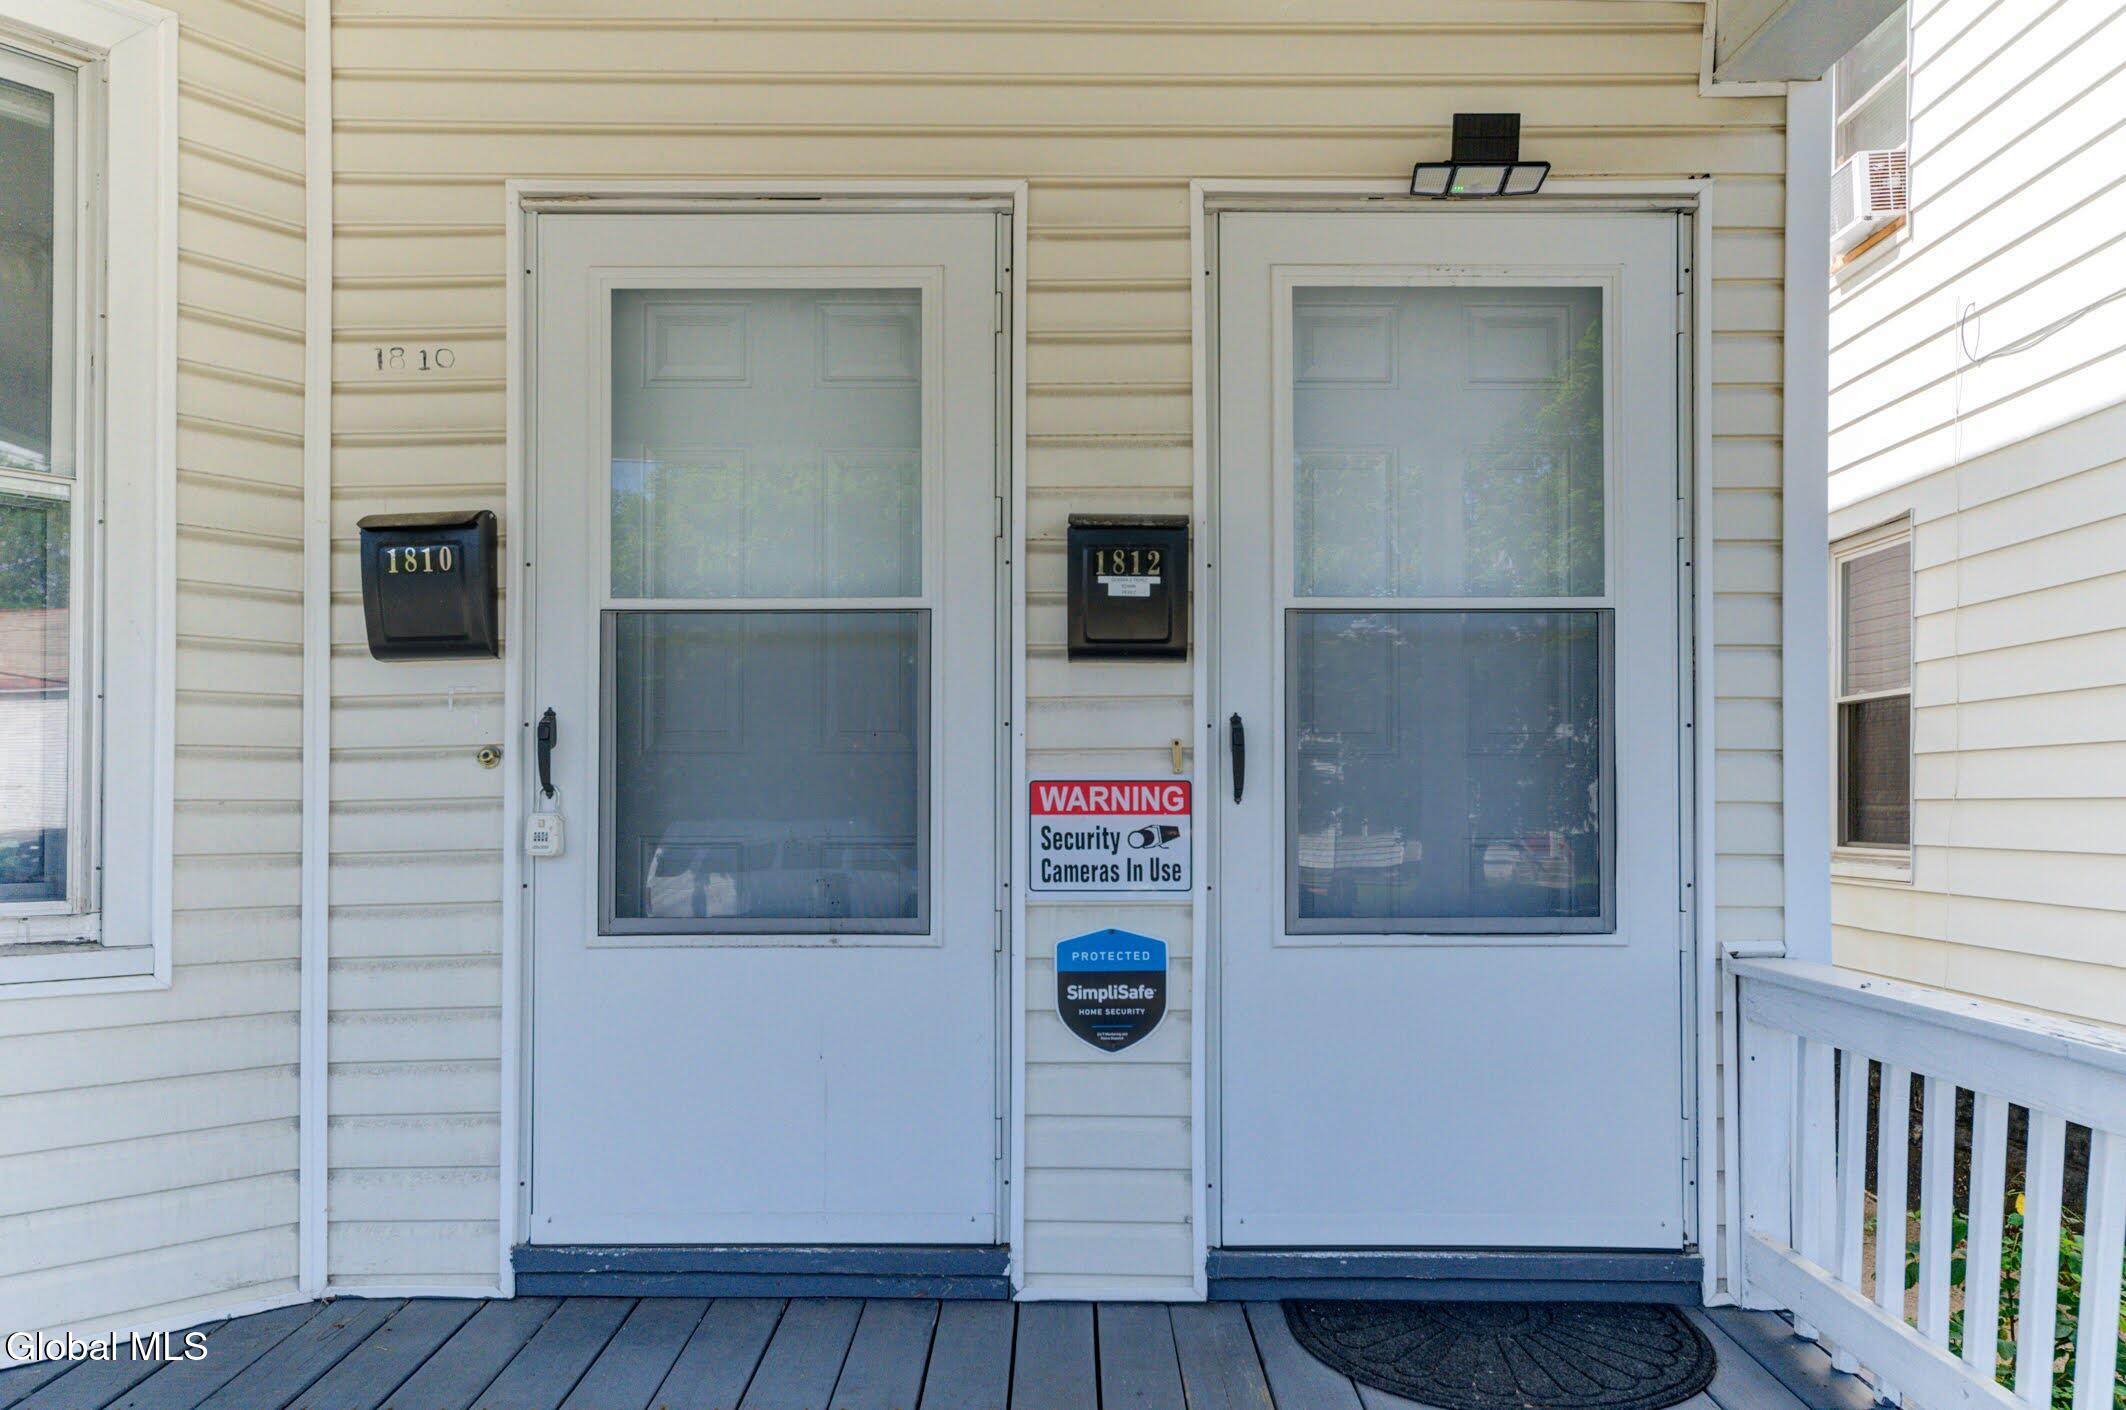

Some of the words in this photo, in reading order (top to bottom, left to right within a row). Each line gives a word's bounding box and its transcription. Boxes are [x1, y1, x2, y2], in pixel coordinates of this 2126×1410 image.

[386, 545, 453, 574] 1810
[1095, 549, 1161, 576] 1812
[1039, 785, 1185, 812] WARNING
[1041, 825, 1121, 855] Security
[1041, 857, 1120, 883] Cameras
[1127, 857, 1143, 882] In
[1150, 857, 1182, 882] Use
[1071, 951, 1151, 961] PROTECTED
[1066, 984, 1156, 1003] SimpliSafe
[1078, 1008, 1103, 1016] HOME
[1105, 1007, 1146, 1016] SECURITY
